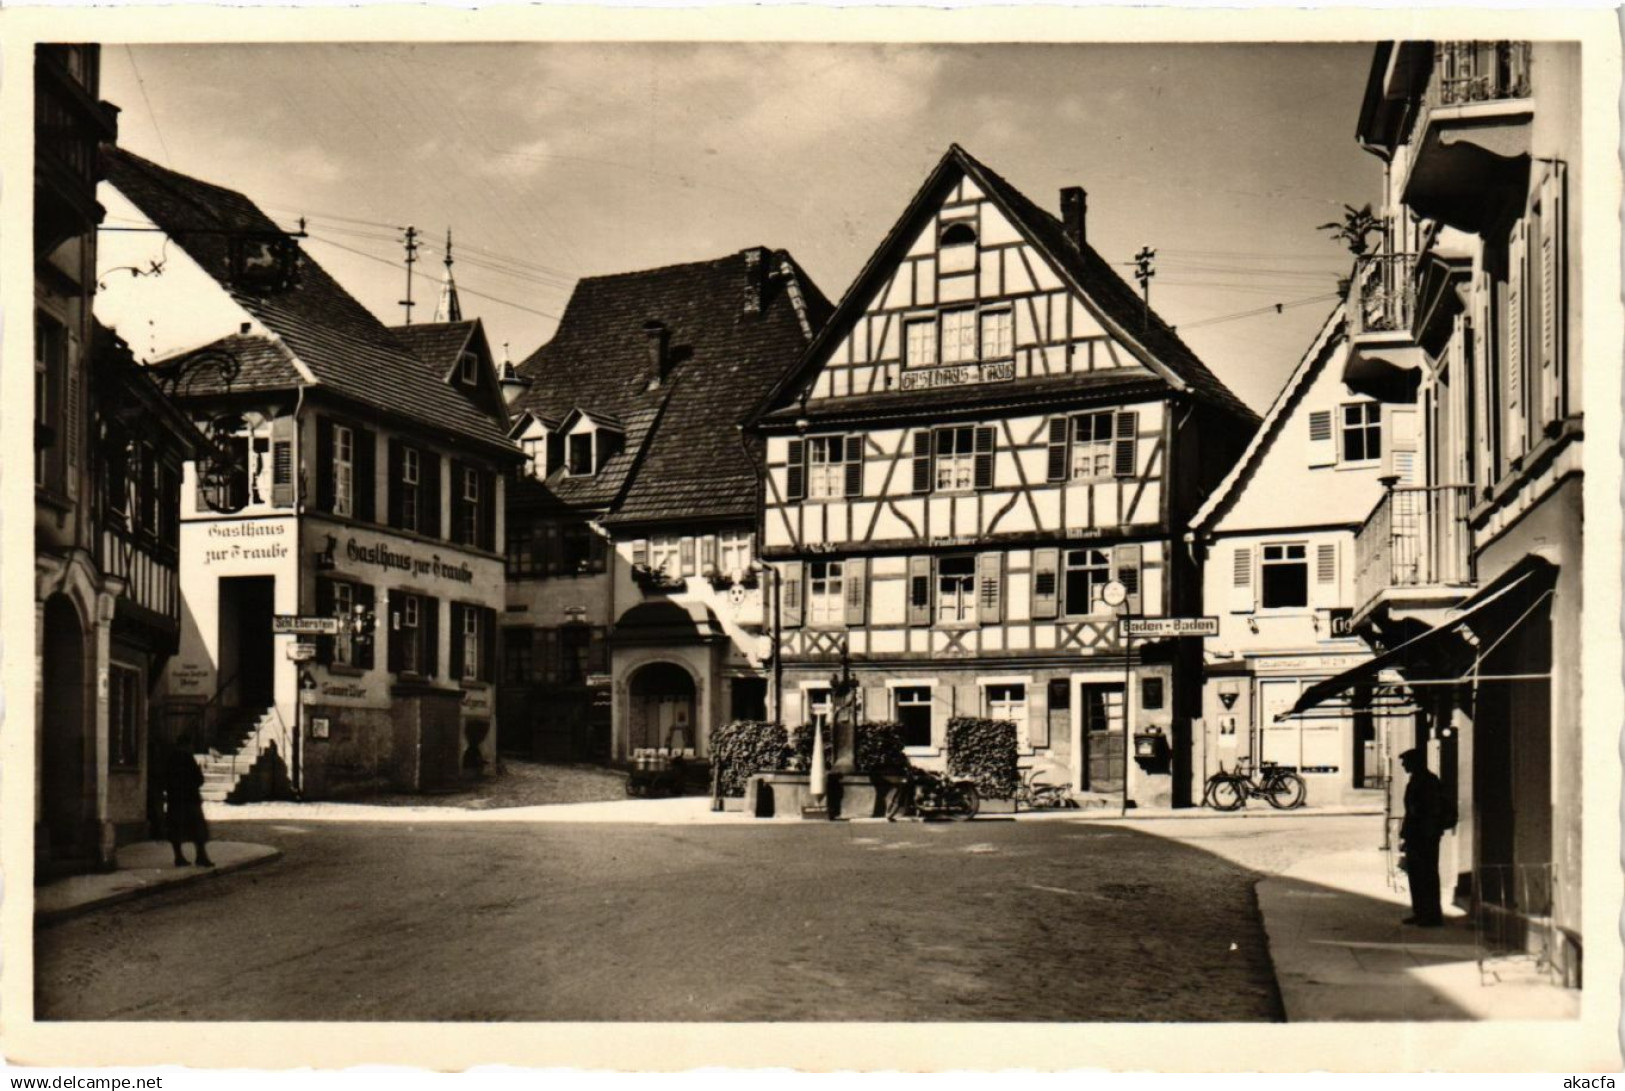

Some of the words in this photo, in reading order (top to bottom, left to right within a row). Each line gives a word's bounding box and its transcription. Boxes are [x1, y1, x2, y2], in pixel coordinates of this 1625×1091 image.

[208, 522, 285, 537] Gasthaus
[204, 550, 229, 565] zur
[346, 538, 411, 572] Gasthaus
[412, 560, 431, 578] zur
[433, 555, 473, 584] Traube
